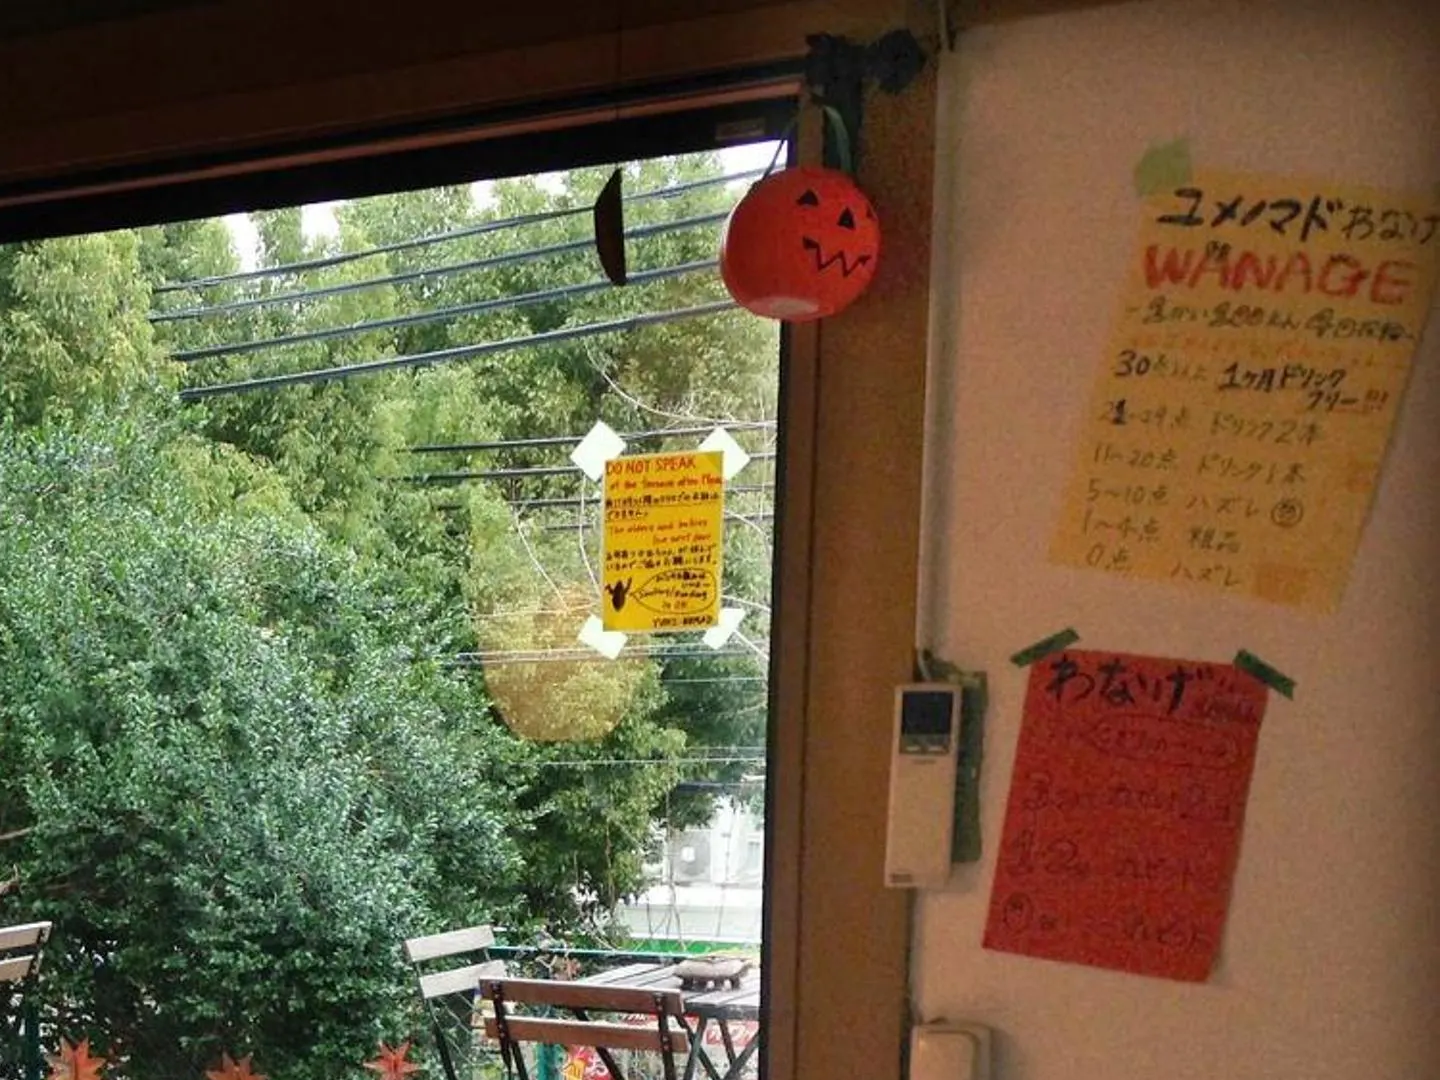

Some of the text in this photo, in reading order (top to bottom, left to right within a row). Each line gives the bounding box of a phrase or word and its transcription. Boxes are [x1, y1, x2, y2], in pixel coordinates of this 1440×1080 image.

[1155, 186, 1343, 242] ユメノマド
[1142, 243, 1417, 305] WANAGE
[625, 458, 650, 474] NOT
